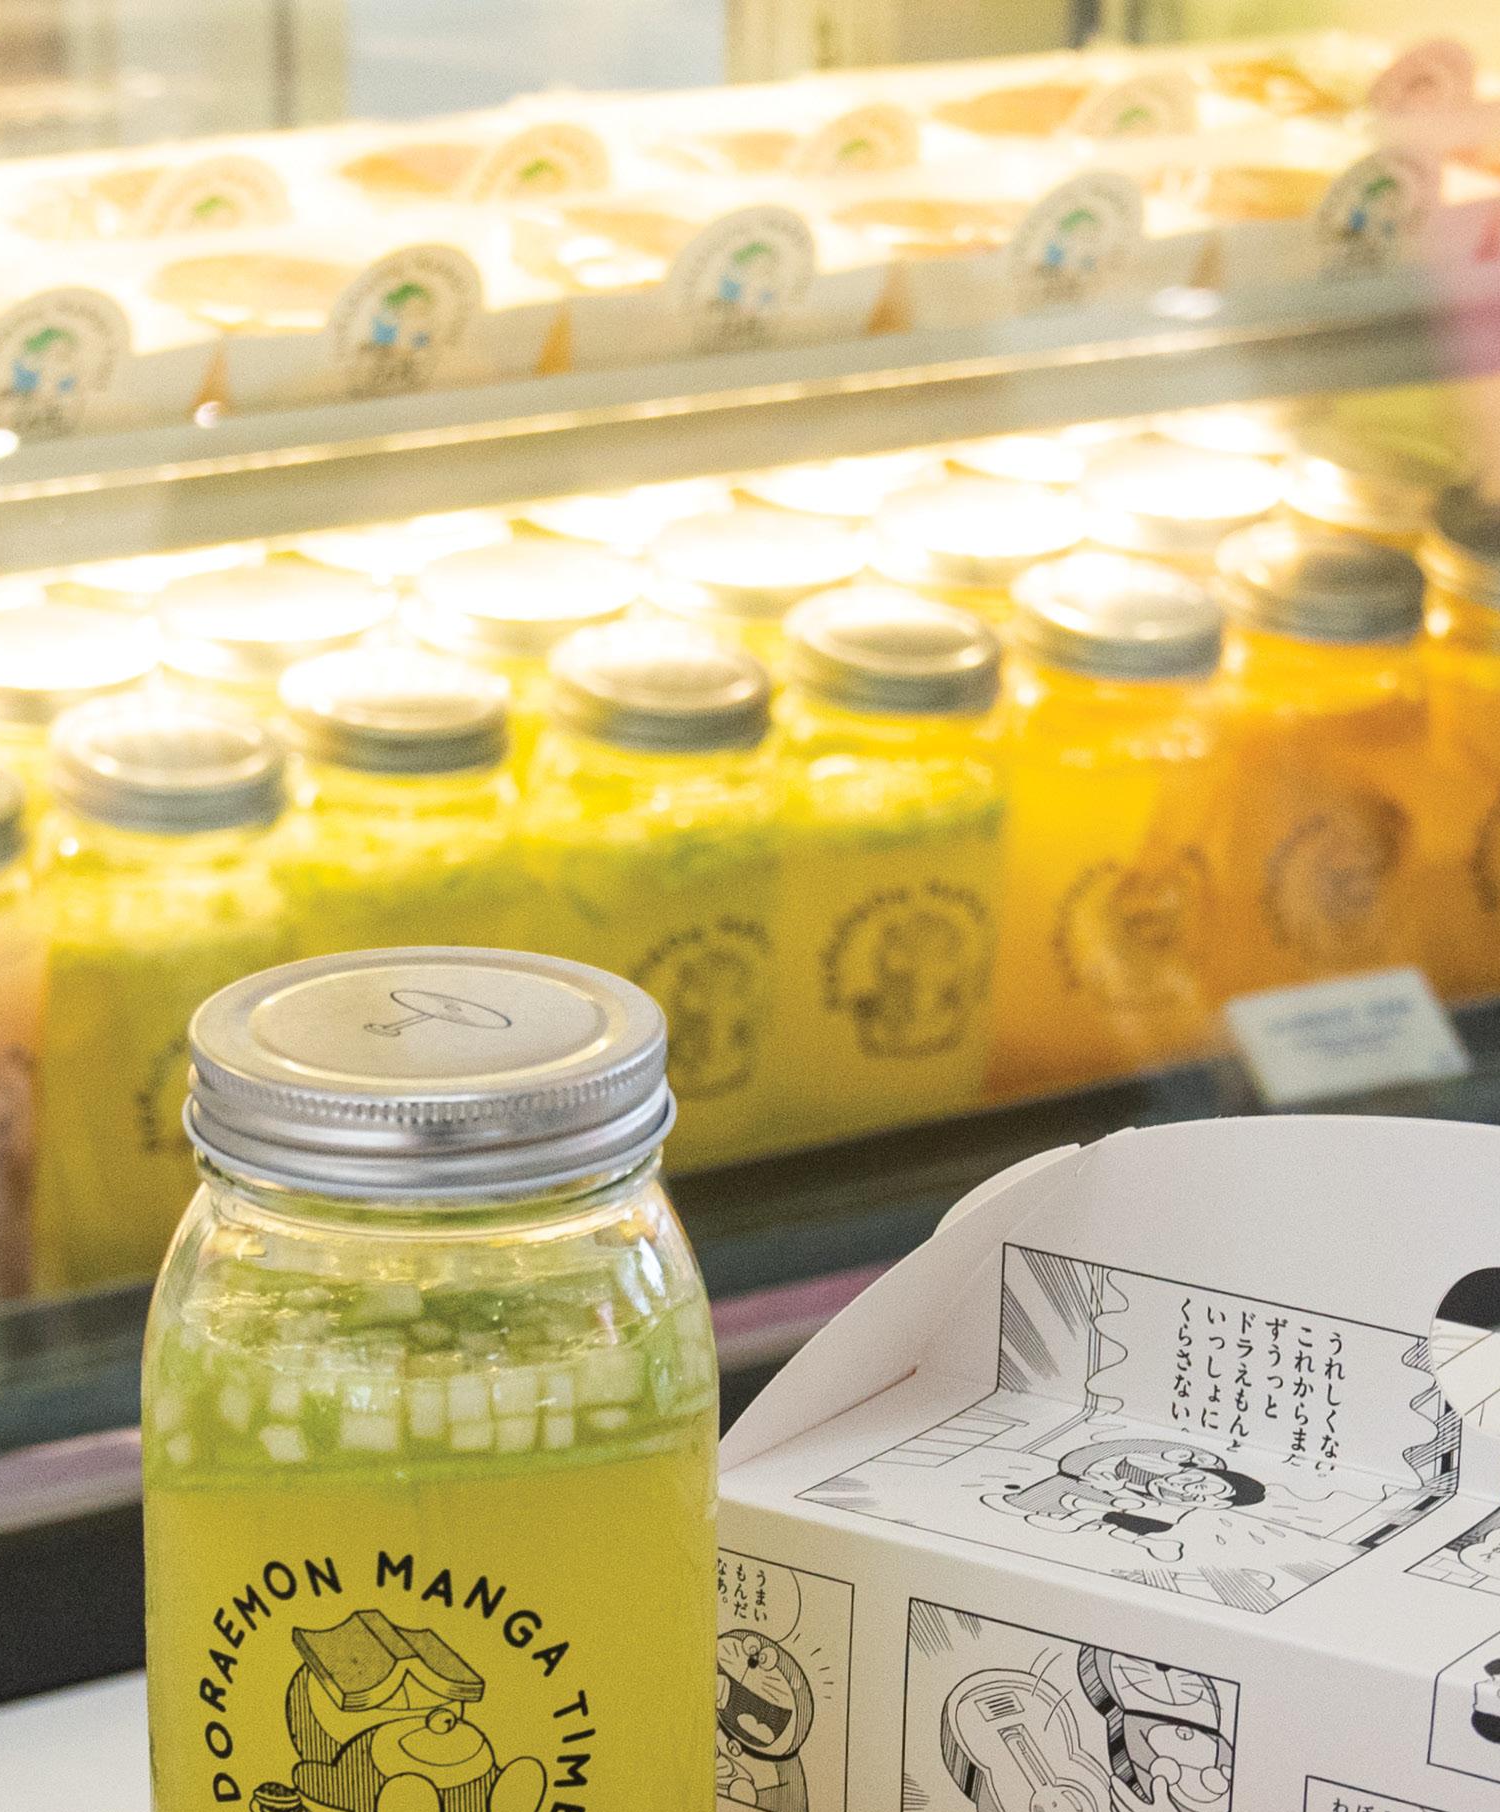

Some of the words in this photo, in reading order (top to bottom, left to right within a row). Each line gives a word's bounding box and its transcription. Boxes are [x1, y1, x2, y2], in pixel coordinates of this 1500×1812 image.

[1200, 1305, 1227, 1430] いっしょに
[1226, 1310, 1256, 1453] ドラえもんと
[1264, 1316, 1289, 1420] ずうっと
[733, 1563, 749, 1620] もんだ
[753, 1569, 768, 1622] うまい
[199, 1556, 343, 1803] DORAEMON
[376, 1550, 570, 1677] MANGA
